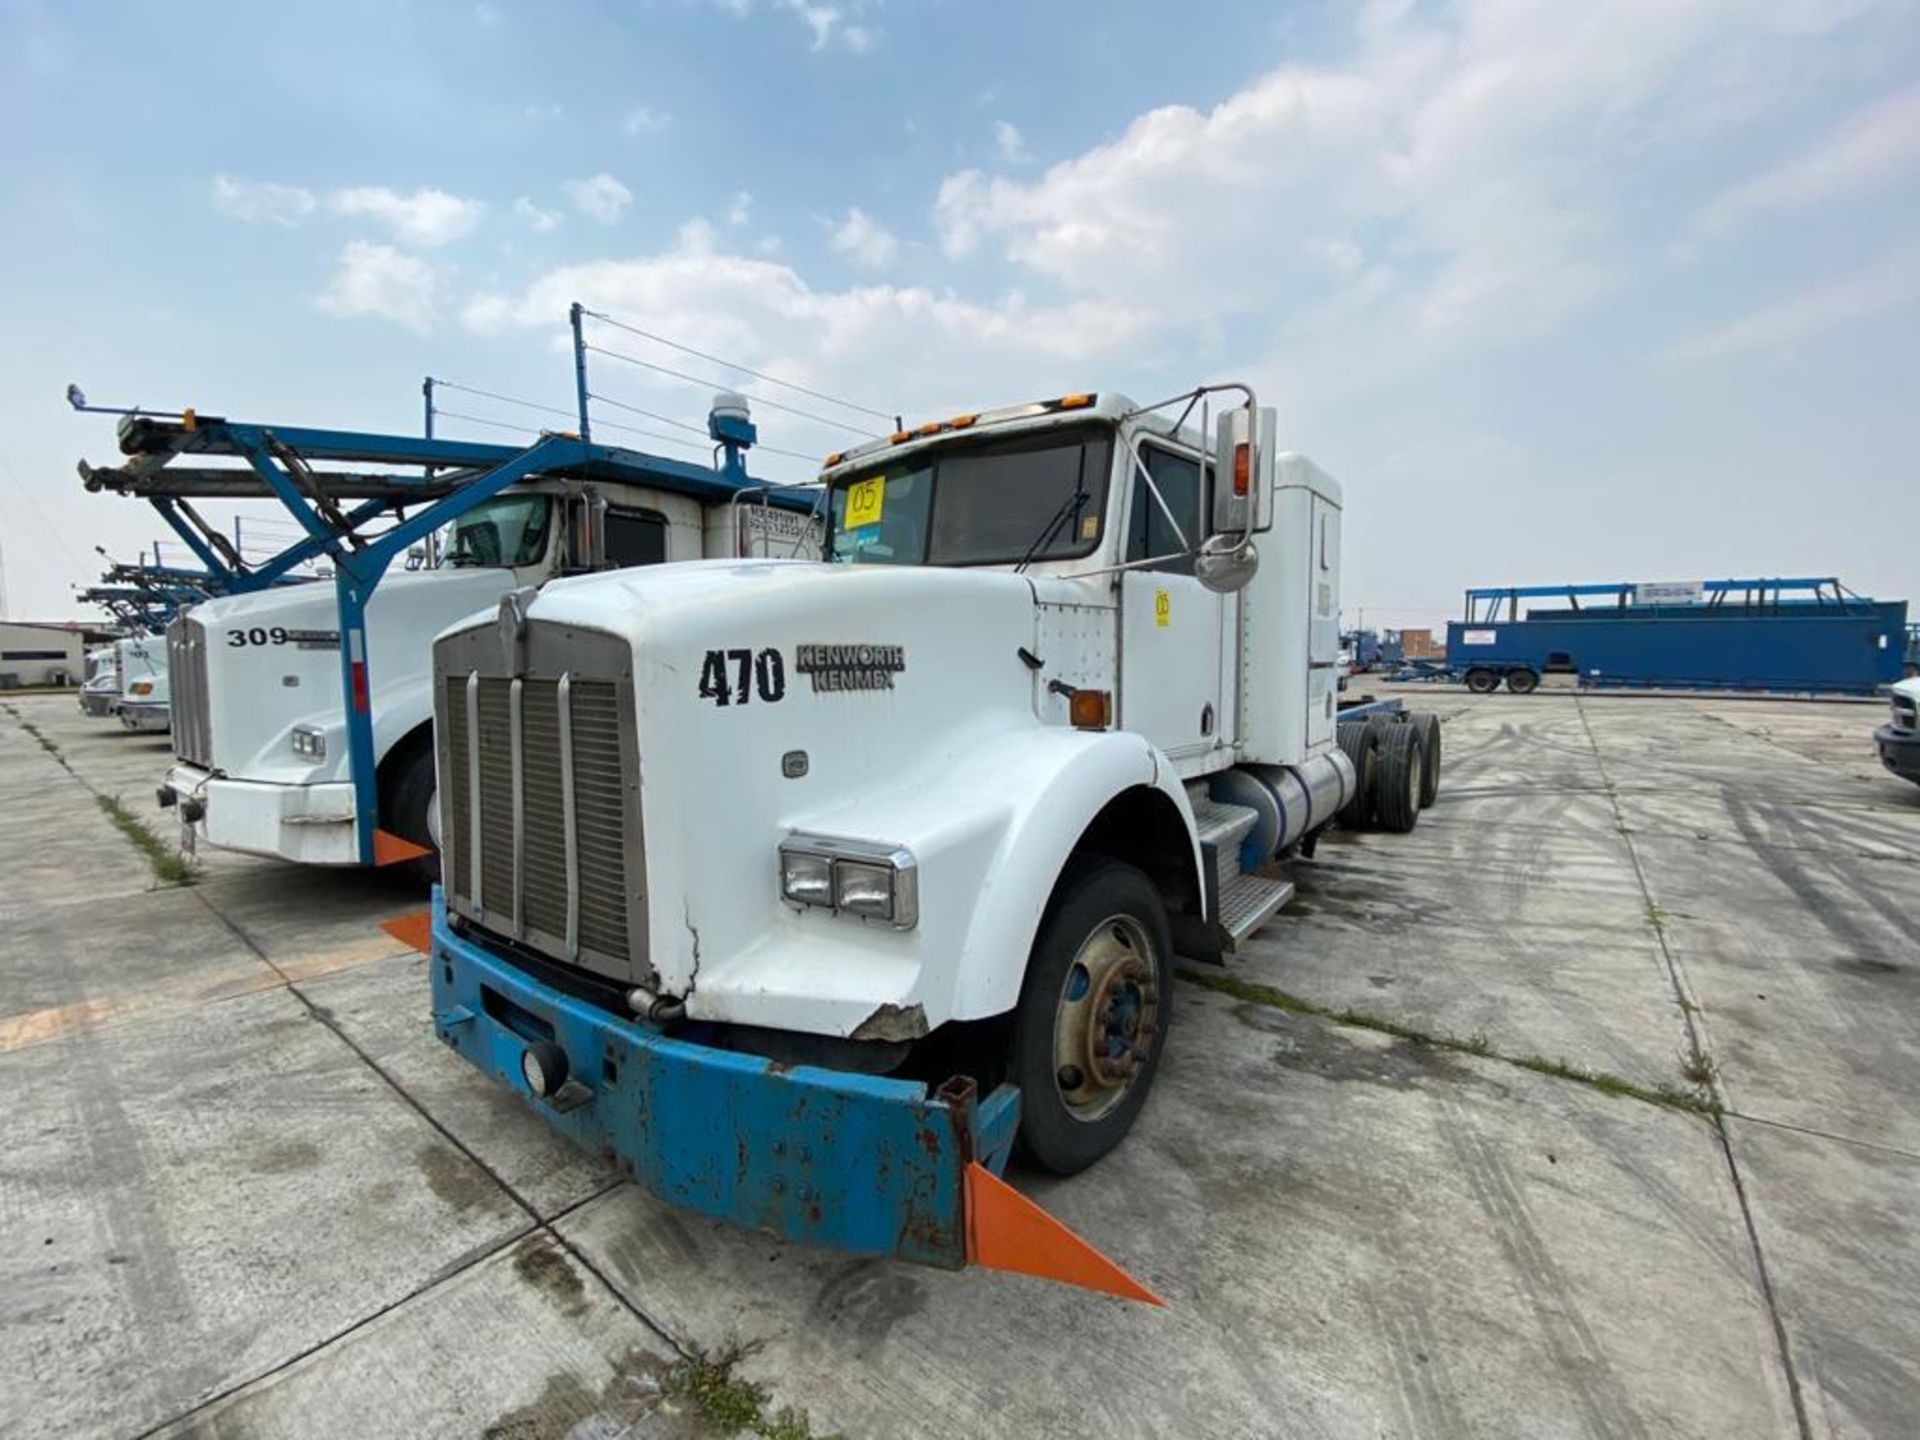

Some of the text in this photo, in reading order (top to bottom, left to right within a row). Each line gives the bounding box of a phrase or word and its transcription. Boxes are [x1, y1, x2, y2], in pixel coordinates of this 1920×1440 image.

[853, 481, 876, 512] 05
[1156, 592, 1169, 615] 05
[227, 627, 288, 648] 309
[797, 645, 904, 668] KENWORTH
[699, 648, 785, 707] 470
[812, 670, 895, 692] KENMEX
